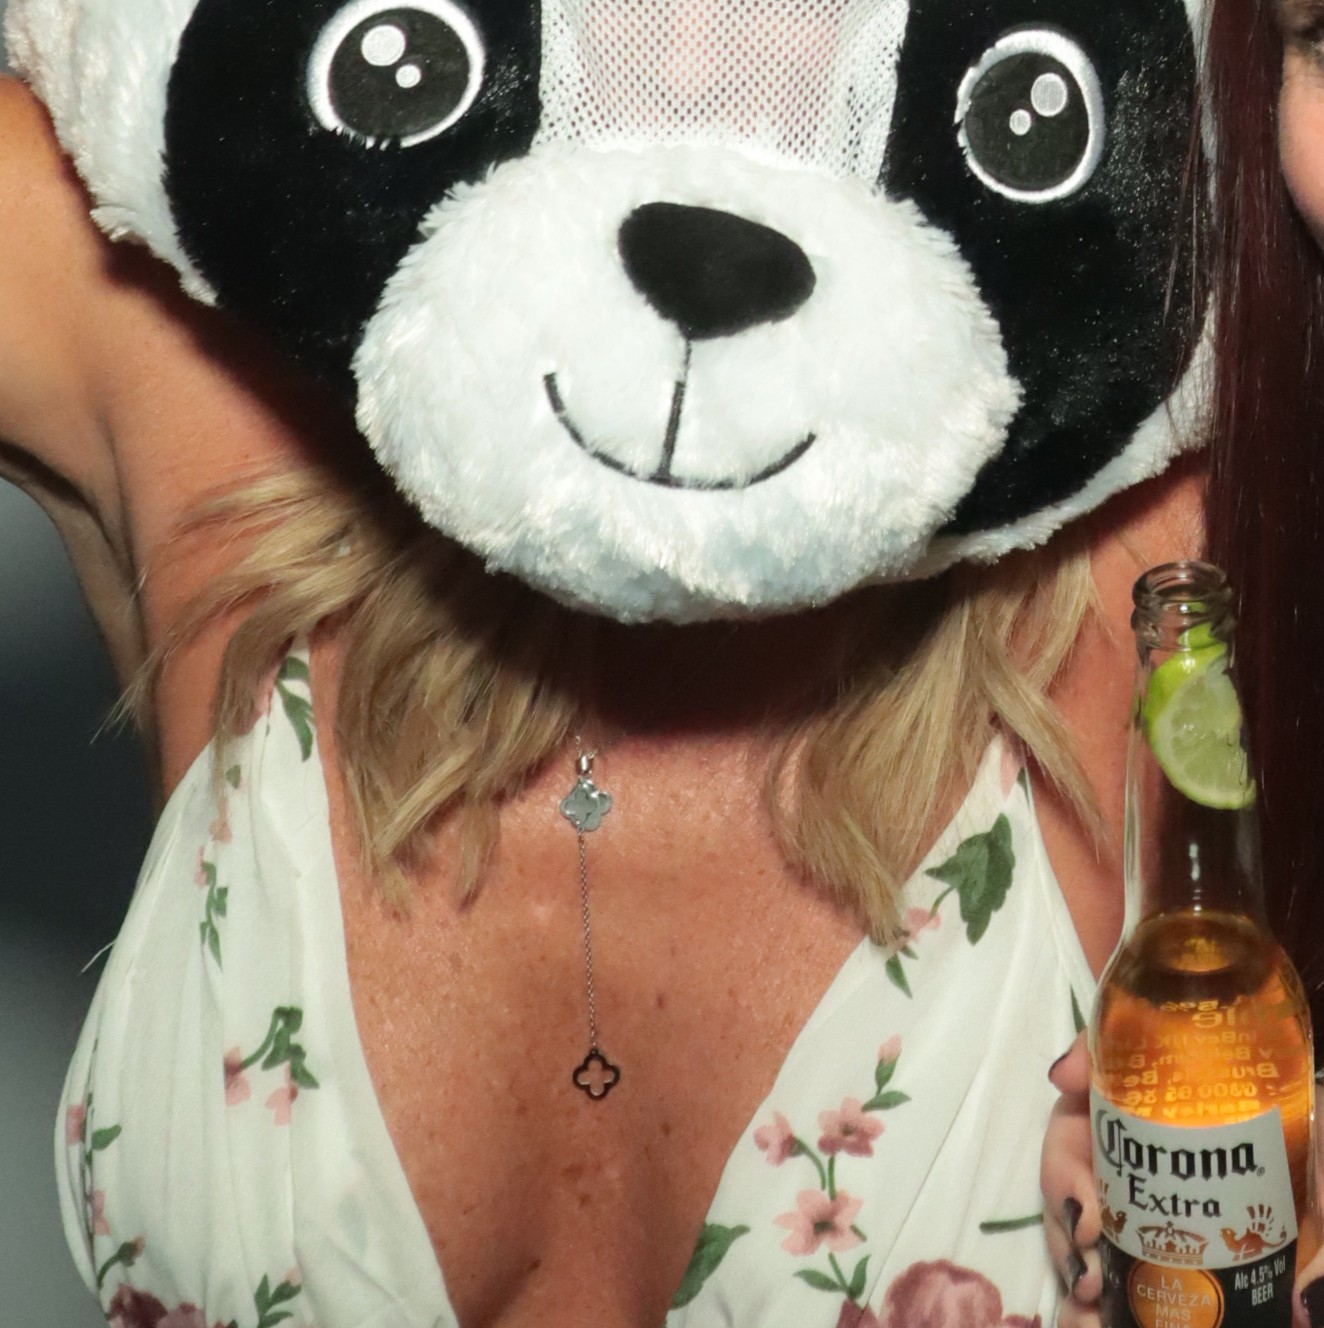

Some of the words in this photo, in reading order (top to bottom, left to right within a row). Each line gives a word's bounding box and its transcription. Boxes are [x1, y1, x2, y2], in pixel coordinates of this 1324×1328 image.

[1095, 1109, 1259, 1182] Corona
[1127, 1173, 1223, 1219] Extra
[1161, 1275, 1183, 1291] LA
[1234, 1271, 1249, 1291] Alc
[1250, 1264, 1273, 1286] 4.5%
[1274, 1255, 1287, 1278] Vol
[1136, 1284, 1212, 1307] CERVEZA
[1251, 1282, 1274, 1307] BEER
[1155, 1303, 1191, 1321] MAS
